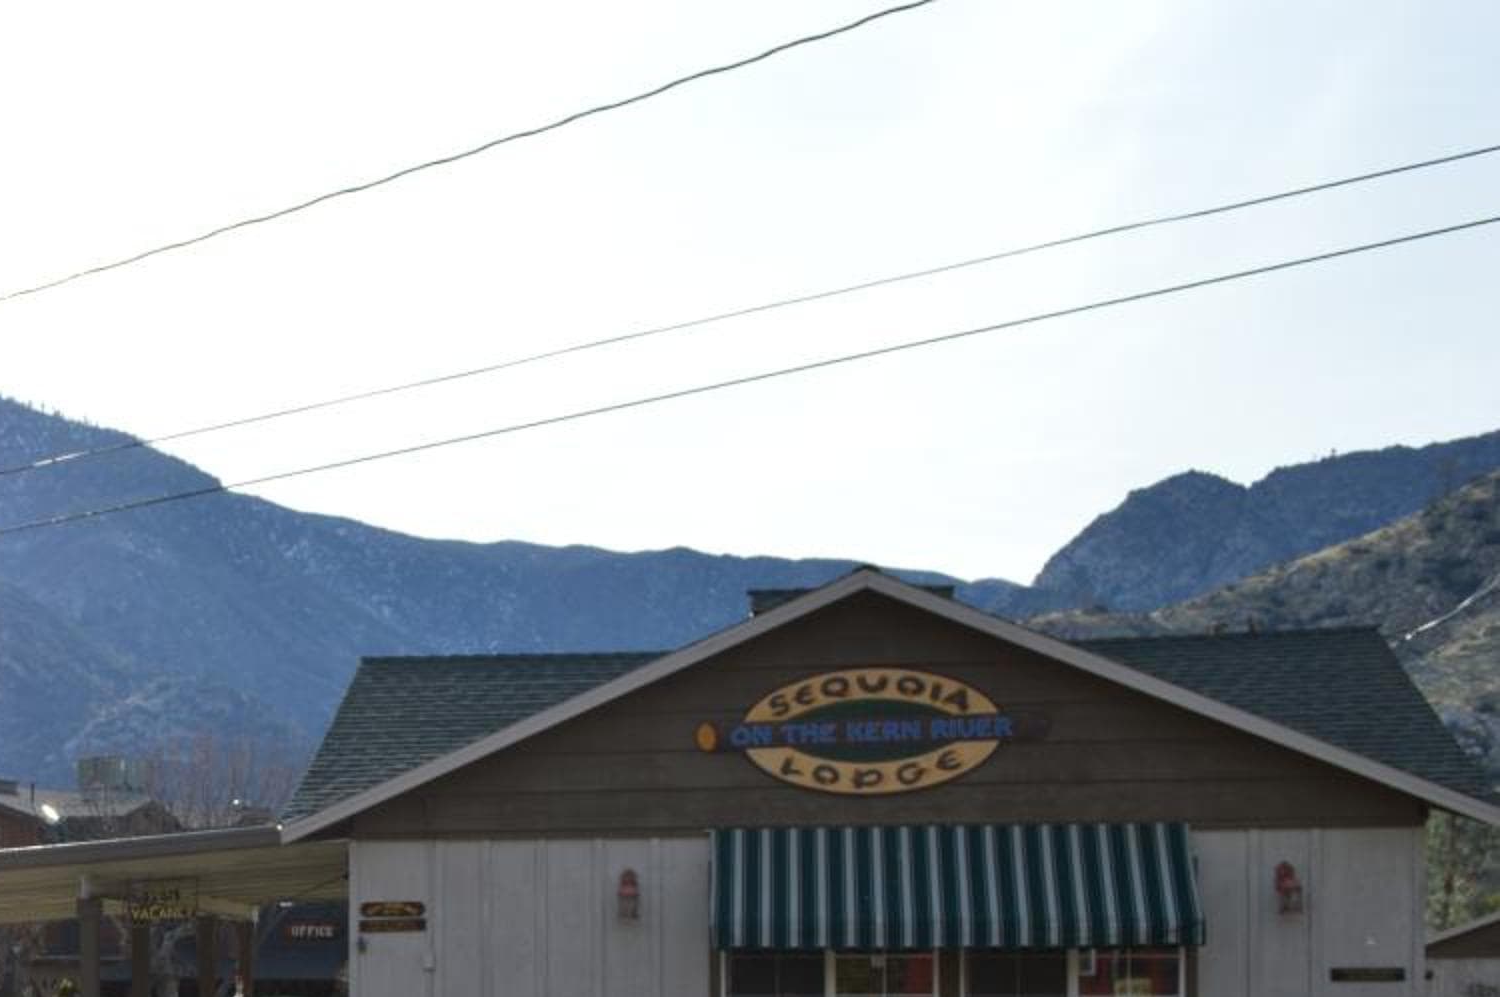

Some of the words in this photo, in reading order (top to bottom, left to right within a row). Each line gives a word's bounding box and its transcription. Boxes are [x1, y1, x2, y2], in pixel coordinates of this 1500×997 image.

[768, 674, 971, 713] SEQUOIA
[729, 723, 772, 747] ON
[780, 721, 837, 744] THE
[846, 719, 921, 742] KERN
[931, 716, 1013, 739] RIVER
[779, 749, 965, 790] LODGE
[291, 925, 334, 938] OFFICE
